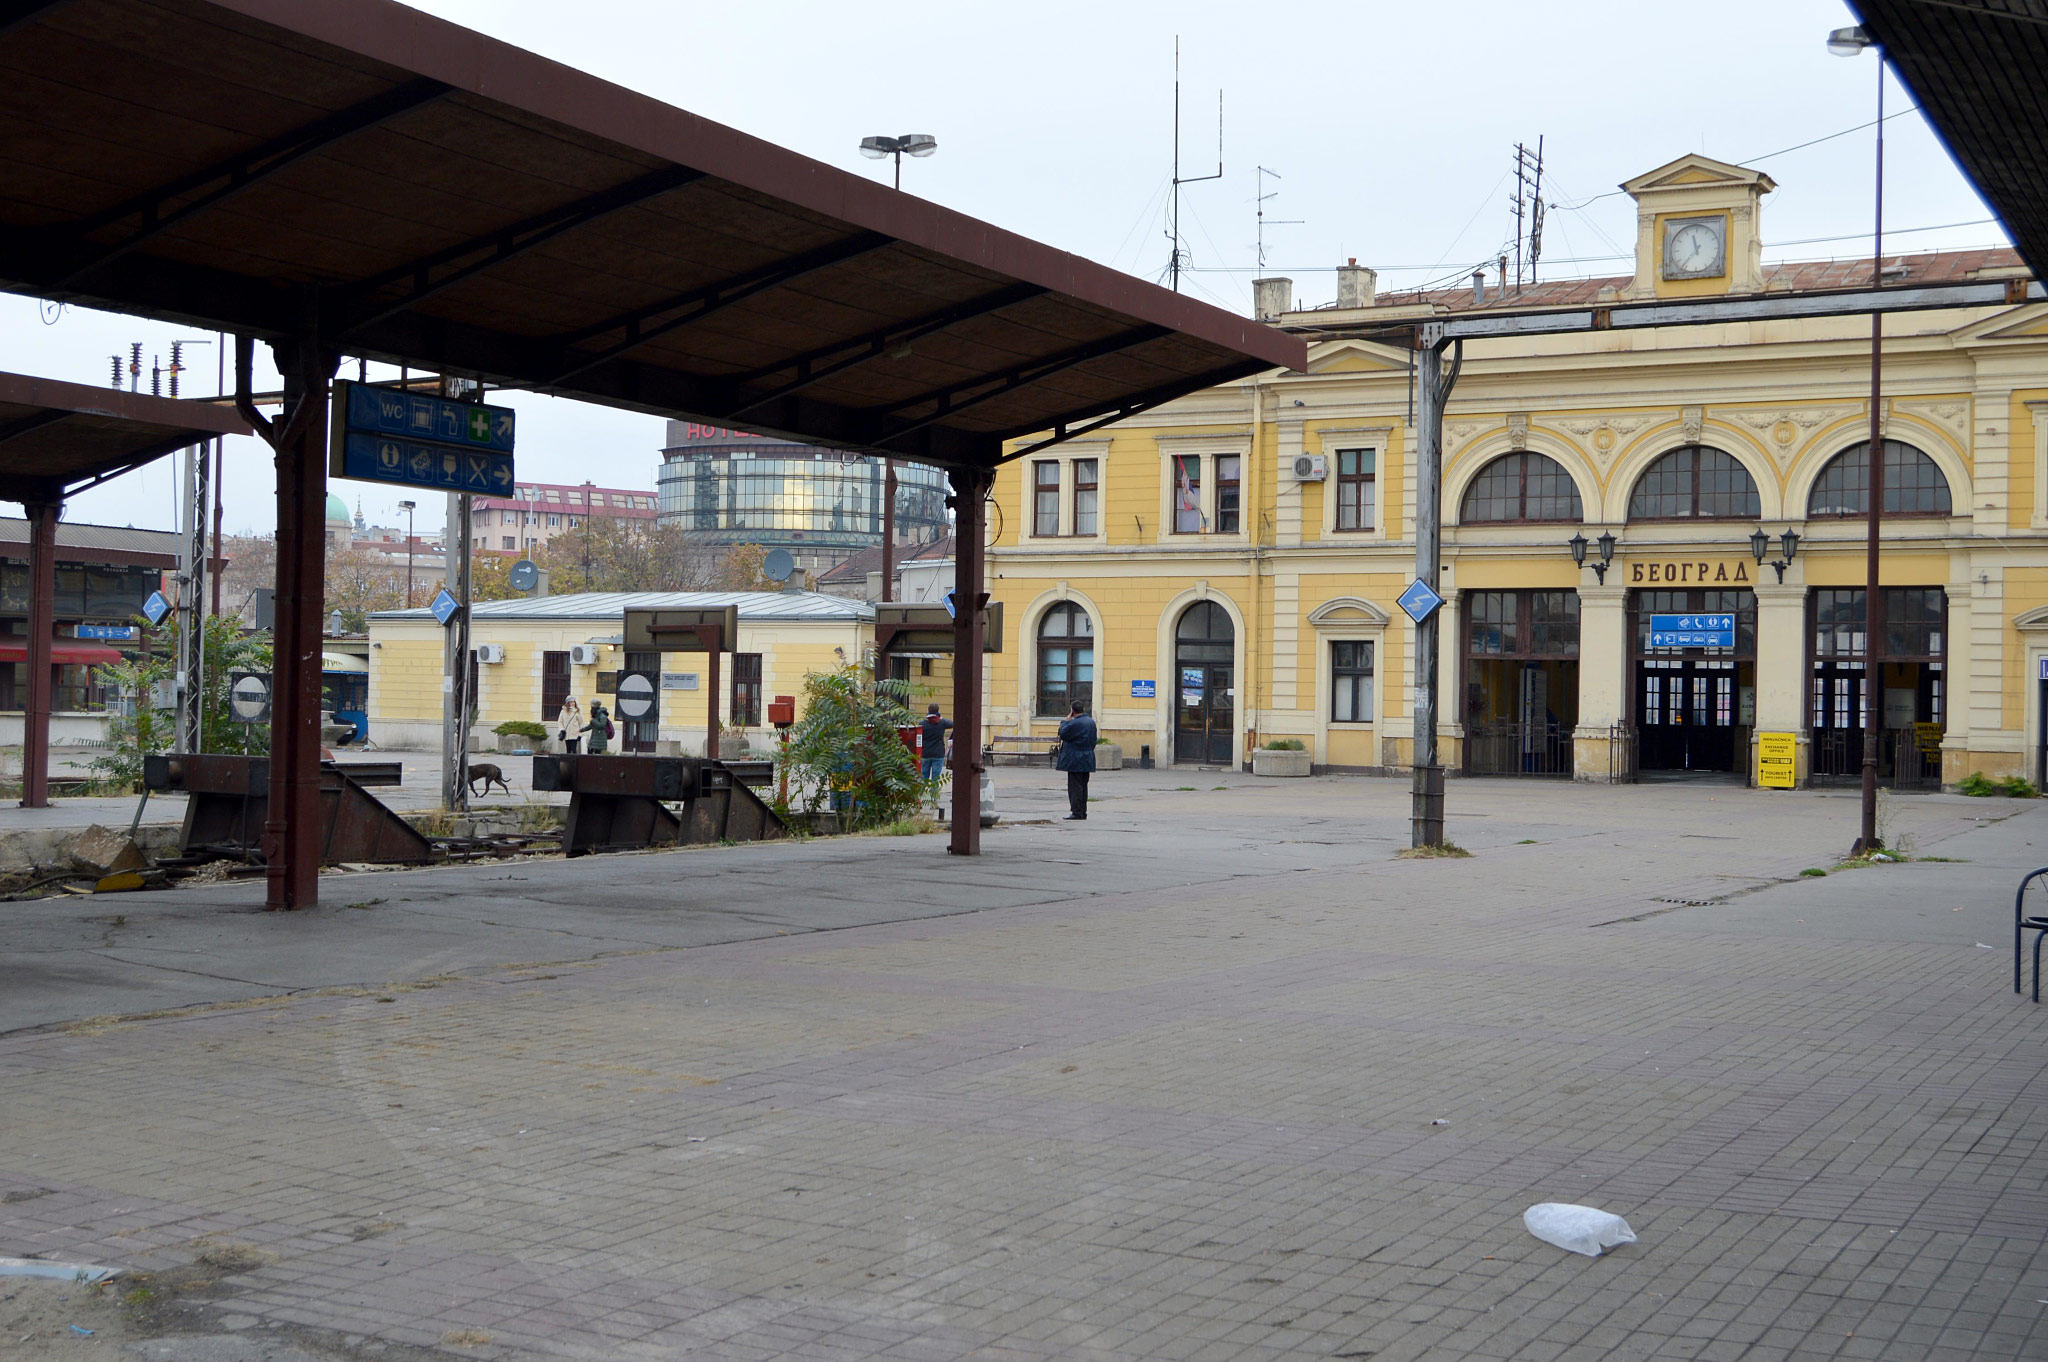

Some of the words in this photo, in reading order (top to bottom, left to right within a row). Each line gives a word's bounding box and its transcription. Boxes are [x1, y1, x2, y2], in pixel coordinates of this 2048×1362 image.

[382, 402, 403, 419] WC
[686, 422, 763, 439] HOT
[1631, 561, 1749, 582] БЕОГРАД
